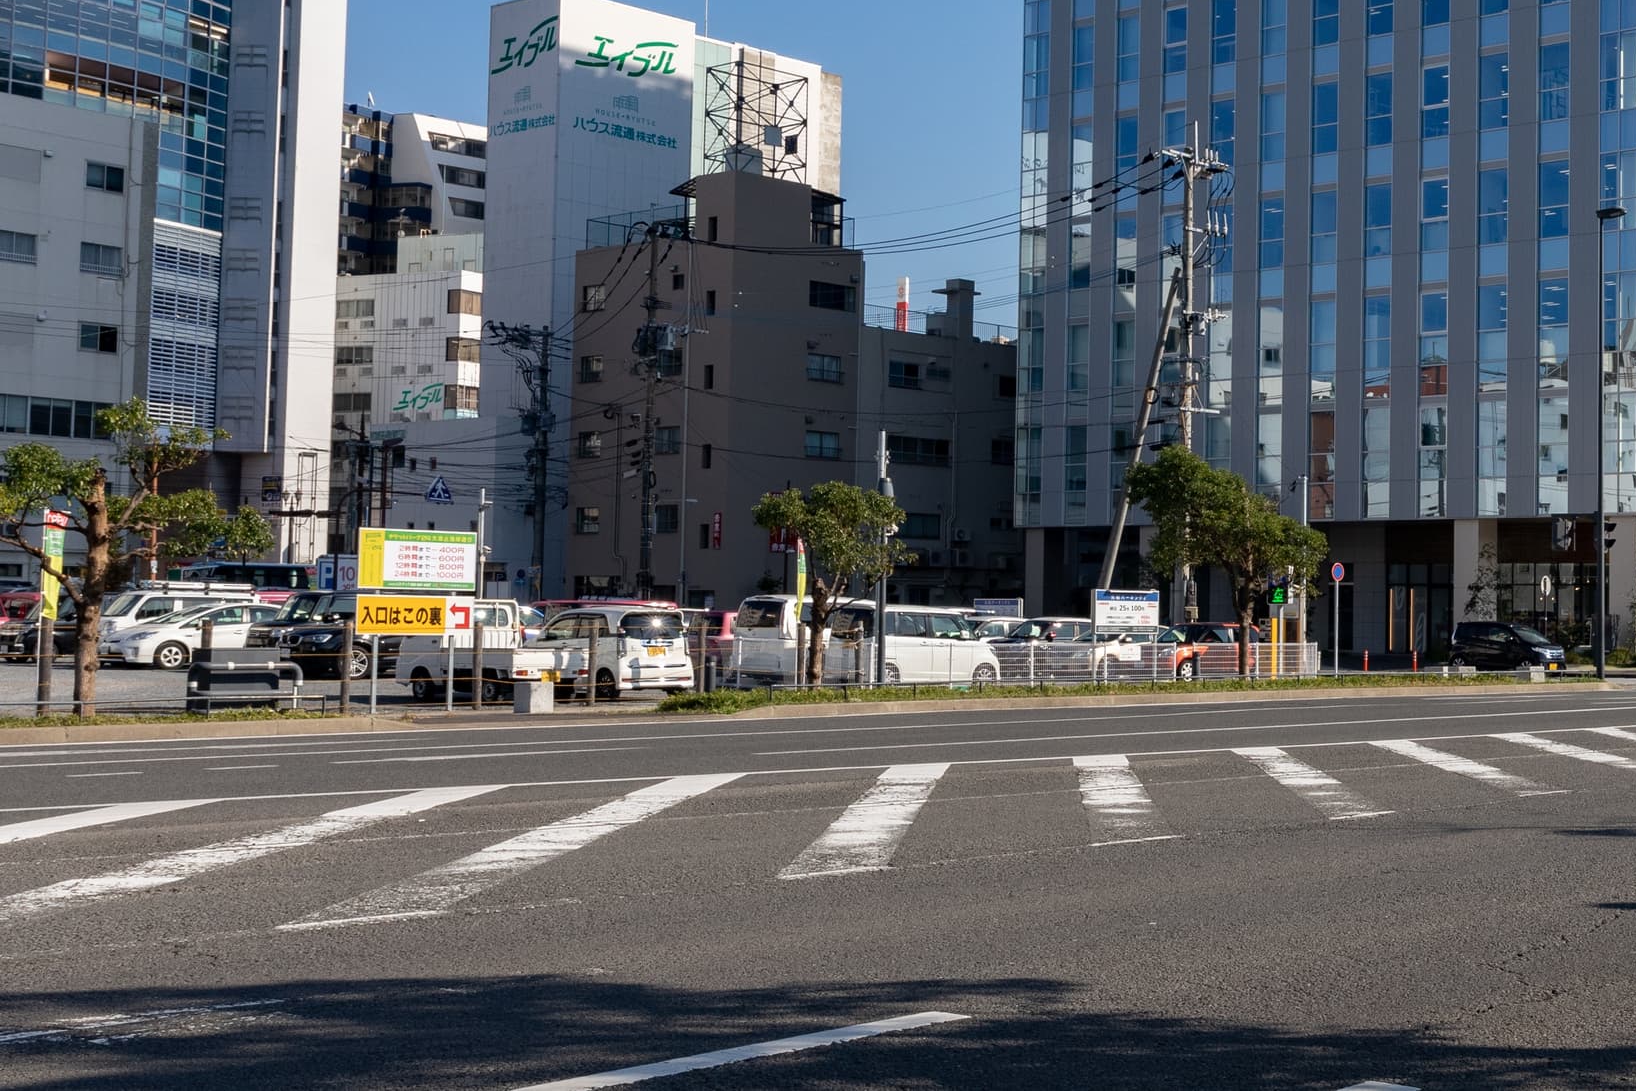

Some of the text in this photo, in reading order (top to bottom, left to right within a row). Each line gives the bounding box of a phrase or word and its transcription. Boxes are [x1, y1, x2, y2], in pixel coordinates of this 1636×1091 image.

[491, 15, 559, 74] エイブル
[575, 35, 679, 77] エイブル
[393, 383, 443, 411] エイブル
[361, 606, 442, 626] 入口はこの裏
